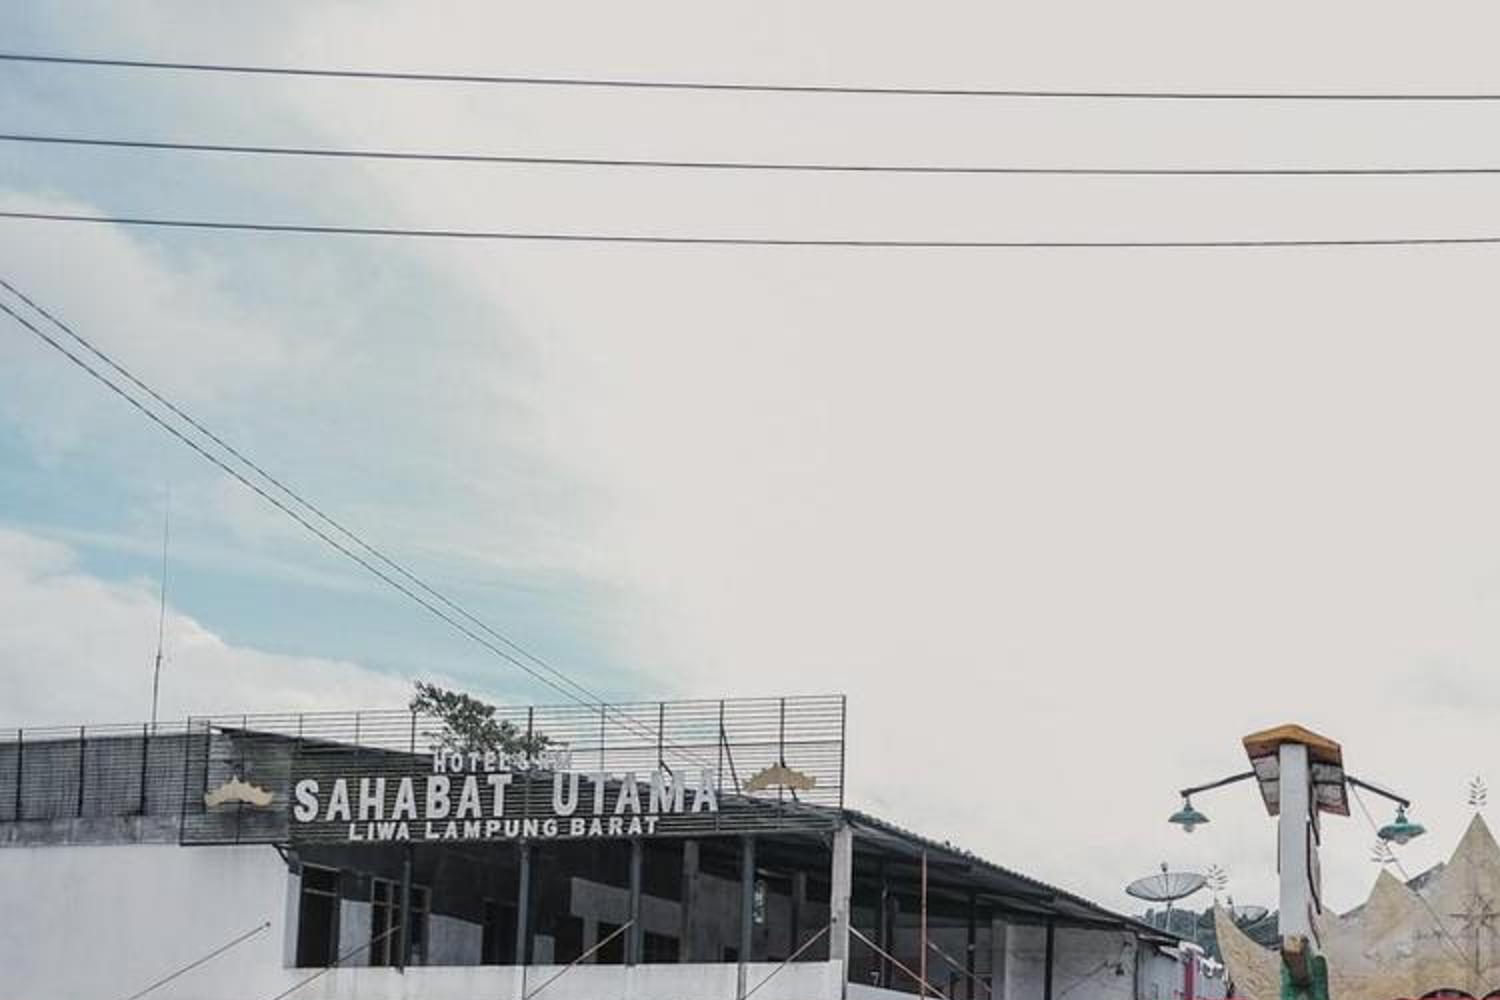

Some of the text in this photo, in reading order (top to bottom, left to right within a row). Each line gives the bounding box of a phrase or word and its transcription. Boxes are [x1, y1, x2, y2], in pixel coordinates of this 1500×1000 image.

[434, 750, 511, 772] HOTEL
[294, 770, 719, 822] SAHABAT UTAMA
[348, 816, 660, 841] LIWA LAMPUNG BARAT
